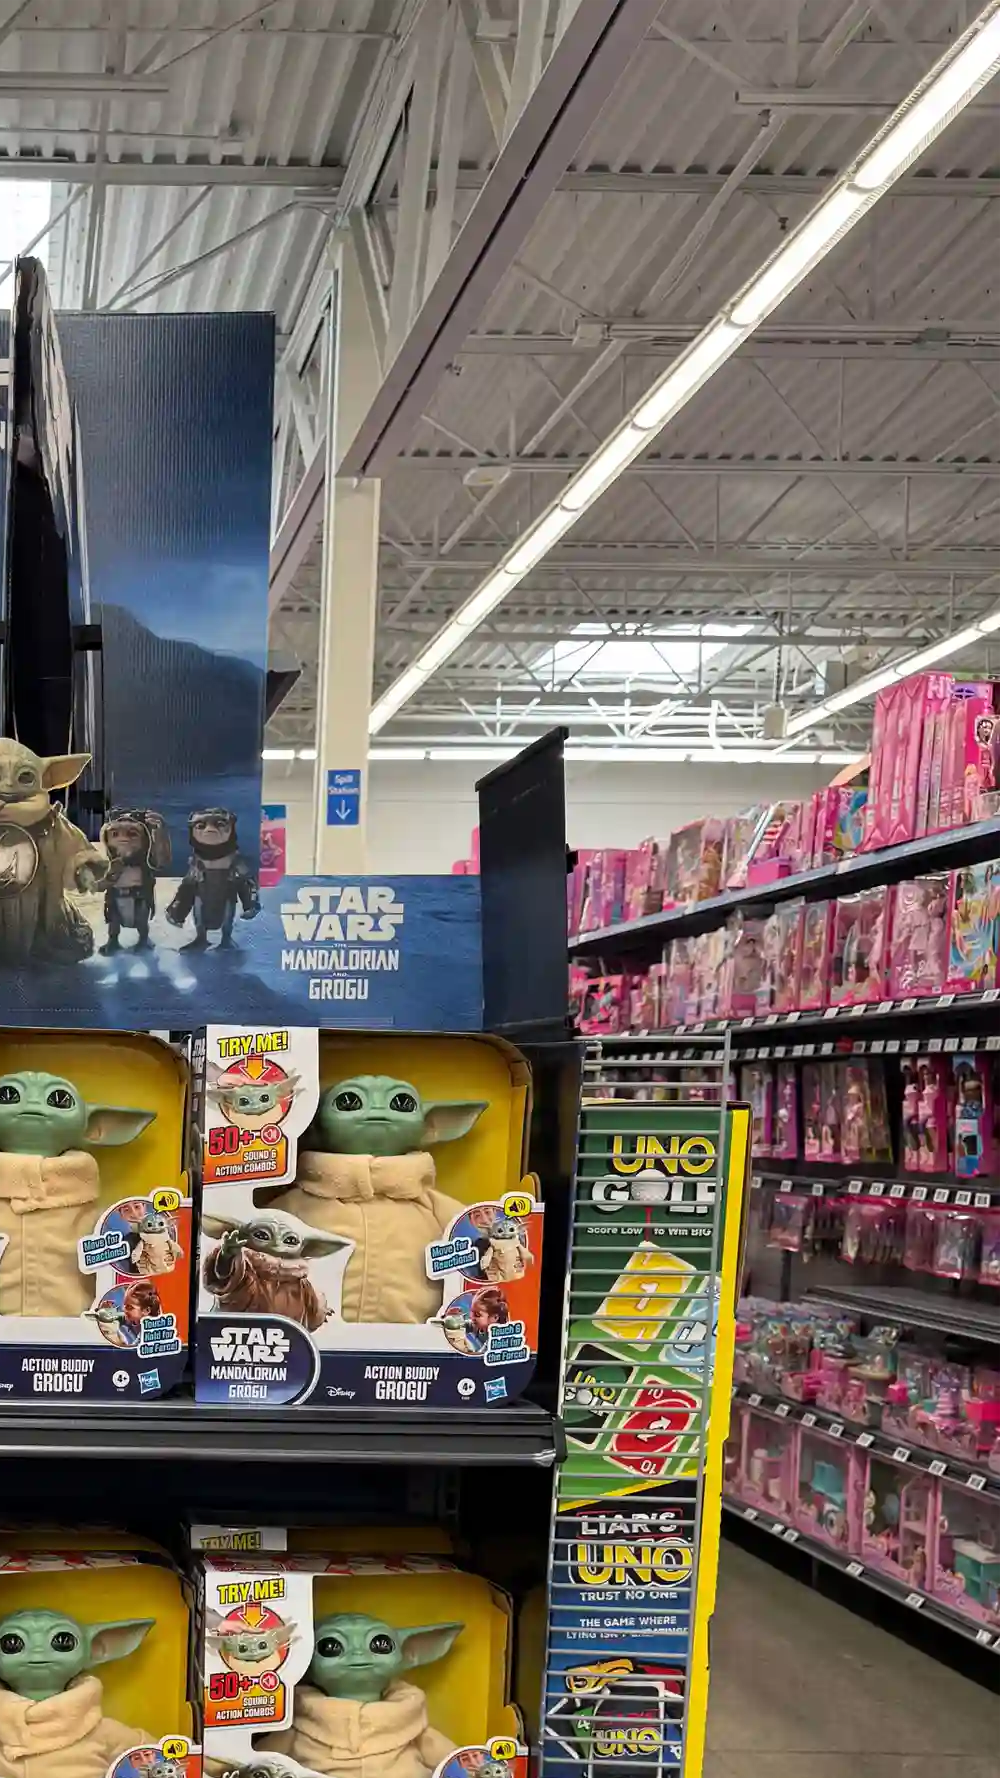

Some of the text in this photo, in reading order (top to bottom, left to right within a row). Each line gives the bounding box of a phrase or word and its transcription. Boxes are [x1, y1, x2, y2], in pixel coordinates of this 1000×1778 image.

[335, 774, 353, 785] Spill
[329, 786, 360, 795] Station
[281, 887, 403, 913] STAR
[281, 915, 403, 941] WARS
[282, 950, 399, 971] MANDALORIAN
[309, 979, 368, 1000] GROGU
[218, 1032, 288, 1057] TRY ME!
[612, 1136, 715, 1174] UNO
[211, 1327, 289, 1345] STAR
[211, 1345, 289, 1363] WARS
[22, 1358, 95, 1373] ACTION BUDDY
[211, 1366, 287, 1381] MANDALORIAN
[229, 1384, 267, 1399] GROGU
[580, 1512, 677, 1535] LIAR'S
[570, 1539, 693, 1586] UNO
[579, 1591, 620, 1602] TRUST
[625, 1590, 644, 1600] NO
[579, 1616, 676, 1627] THE GAME WHERE
[592, 1729, 661, 1757] UNO
